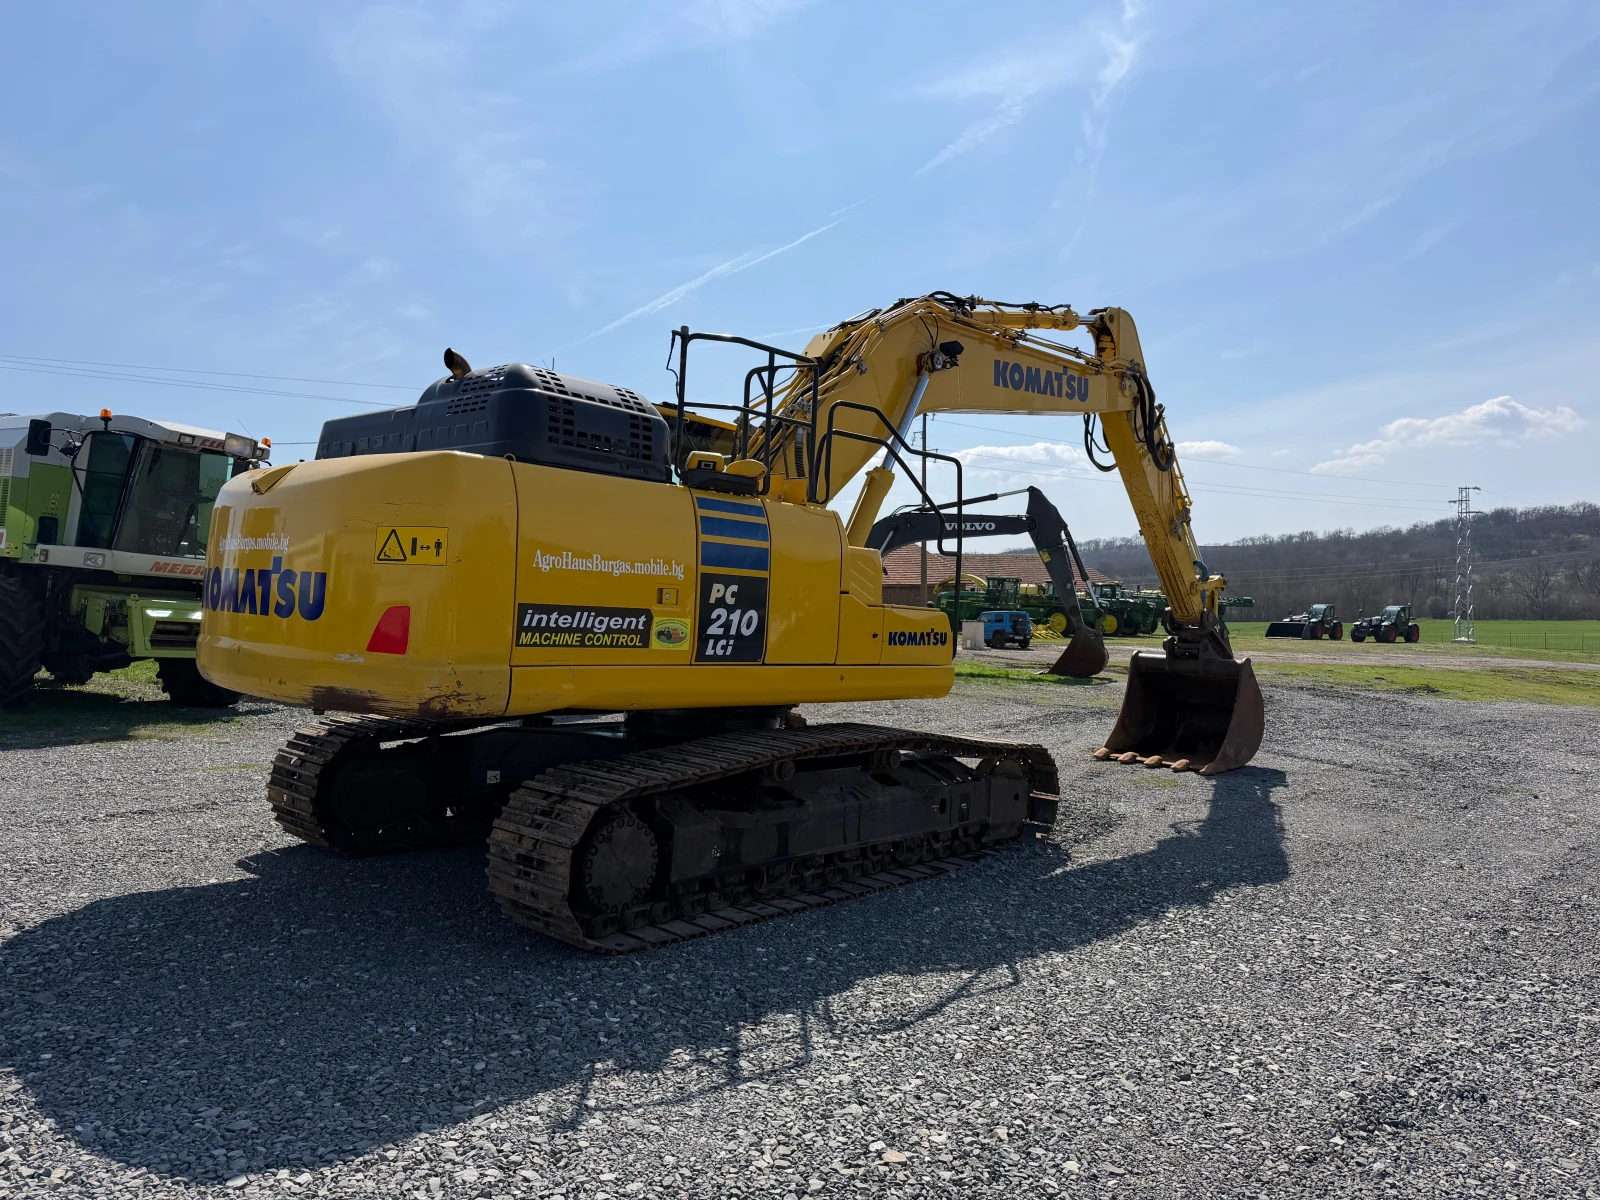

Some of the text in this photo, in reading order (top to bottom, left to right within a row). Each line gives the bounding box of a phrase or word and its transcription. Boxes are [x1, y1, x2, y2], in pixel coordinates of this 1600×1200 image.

[994, 359, 1089, 402] KOMATSU
[200, 438, 226, 449] CLA
[944, 522, 996, 531] VOLVO
[532, 549, 684, 580] AgroHausBurgas.mobile.bg
[202, 556, 327, 621] KOMATSU
[708, 583, 739, 605] PC
[523, 609, 647, 633] intelligent
[706, 607, 759, 637] 210
[519, 632, 582, 646] MACHINE
[584, 633, 643, 646] CONTROL
[705, 638, 735, 656] LCi
[888, 627, 948, 646] KOMATSU
